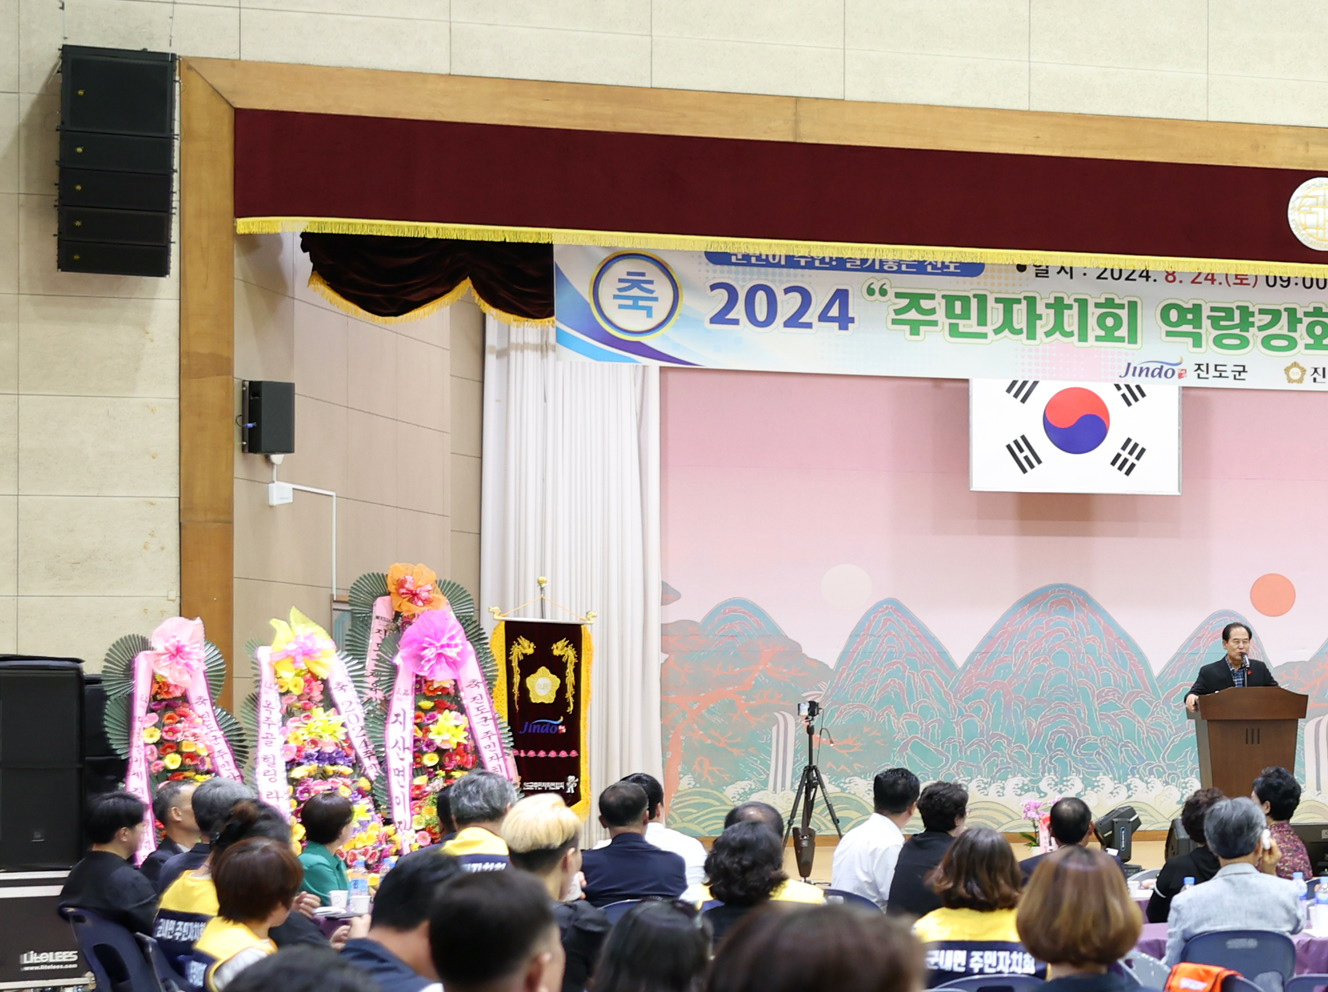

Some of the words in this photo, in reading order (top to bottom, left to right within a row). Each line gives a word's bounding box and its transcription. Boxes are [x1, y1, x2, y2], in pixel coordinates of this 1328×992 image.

[612, 269, 660, 320] 축
[708, 282, 855, 331] 2024
[1193, 363, 1248, 381] 진도군
[519, 720, 558, 734] Jindo
[926, 949, 967, 973] 군내면
[969, 951, 1036, 975] 주민자치회
